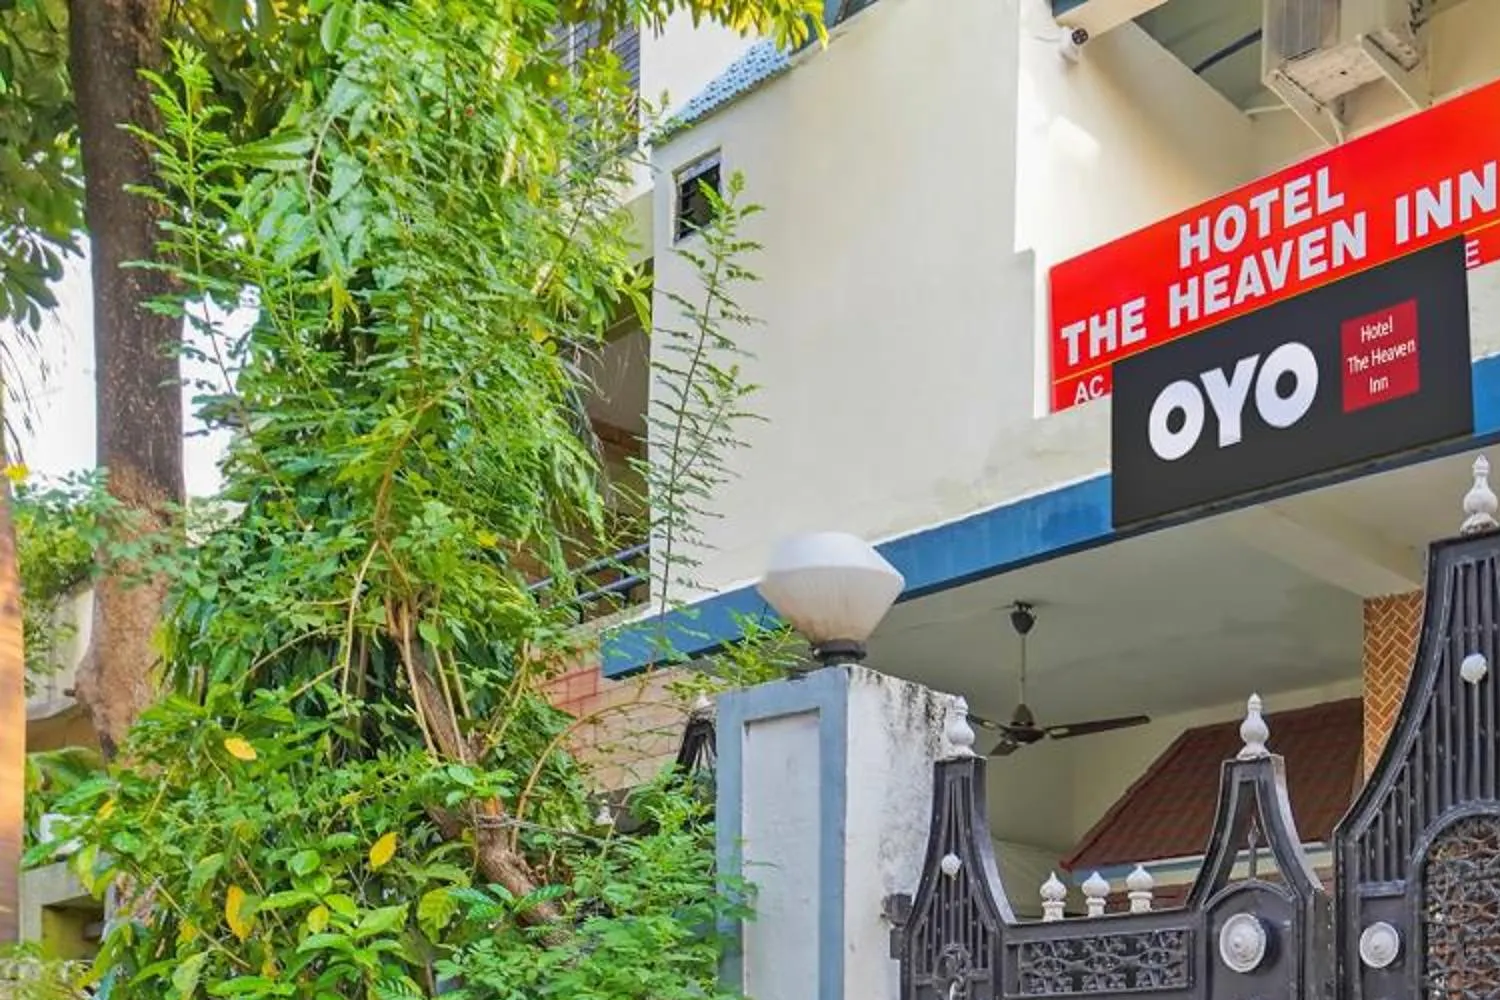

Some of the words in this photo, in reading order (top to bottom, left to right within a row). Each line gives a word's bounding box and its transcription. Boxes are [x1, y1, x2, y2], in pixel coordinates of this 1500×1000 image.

[1179, 166, 1344, 270] HOTEL
[1061, 297, 1147, 366] THE
[1168, 212, 1366, 329] HEAVEN
[1395, 160, 1497, 245] INN
[1360, 314, 1393, 344] Hotel
[1347, 355, 1369, 375] The
[1371, 338, 1416, 367] Heaven
[1074, 375, 1104, 405] AC
[1148, 342, 1318, 461] OYO
[1369, 376, 1389, 395] Inn
